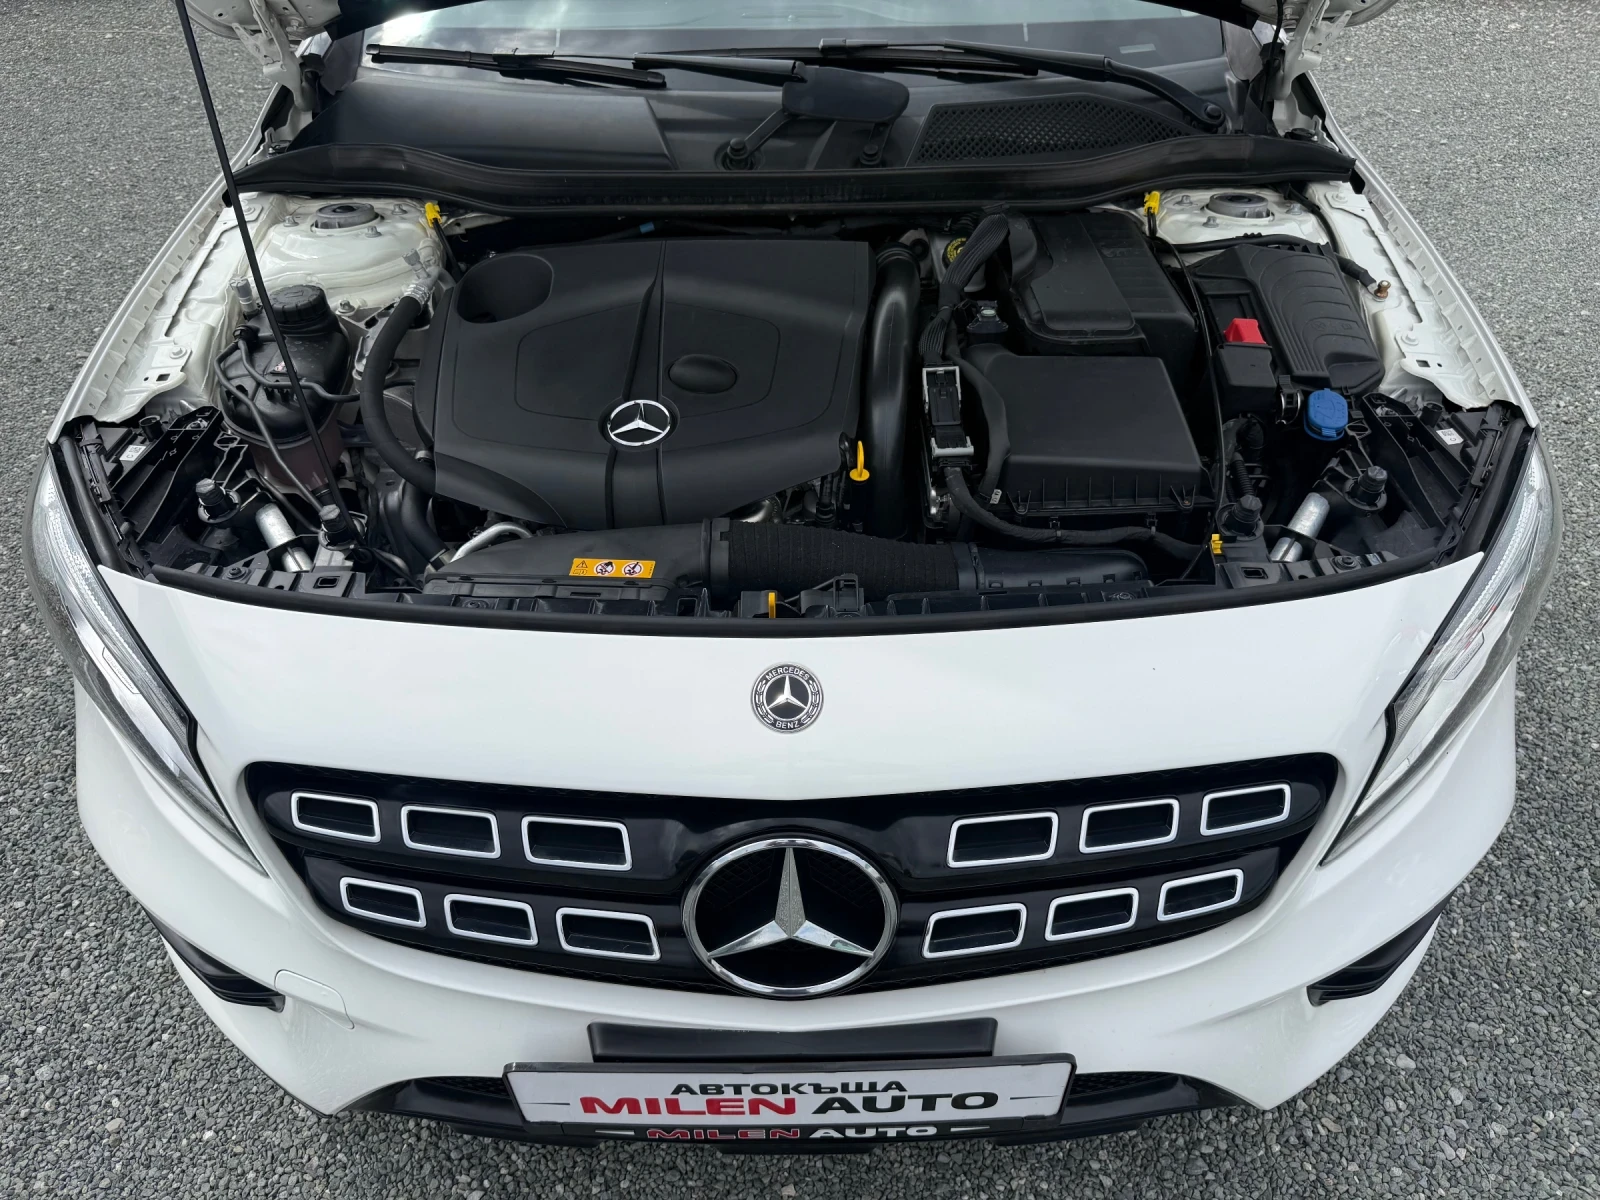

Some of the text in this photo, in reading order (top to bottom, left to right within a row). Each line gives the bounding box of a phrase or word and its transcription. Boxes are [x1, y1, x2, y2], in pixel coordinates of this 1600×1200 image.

[765, 666, 811, 681] MERCEDES
[775, 720, 801, 729] BENZ
[669, 1080, 908, 1096] АВТОКЪША
[579, 1091, 999, 1116] MILEN AUTO
[646, 1125, 938, 1140] MILEN AUTO
